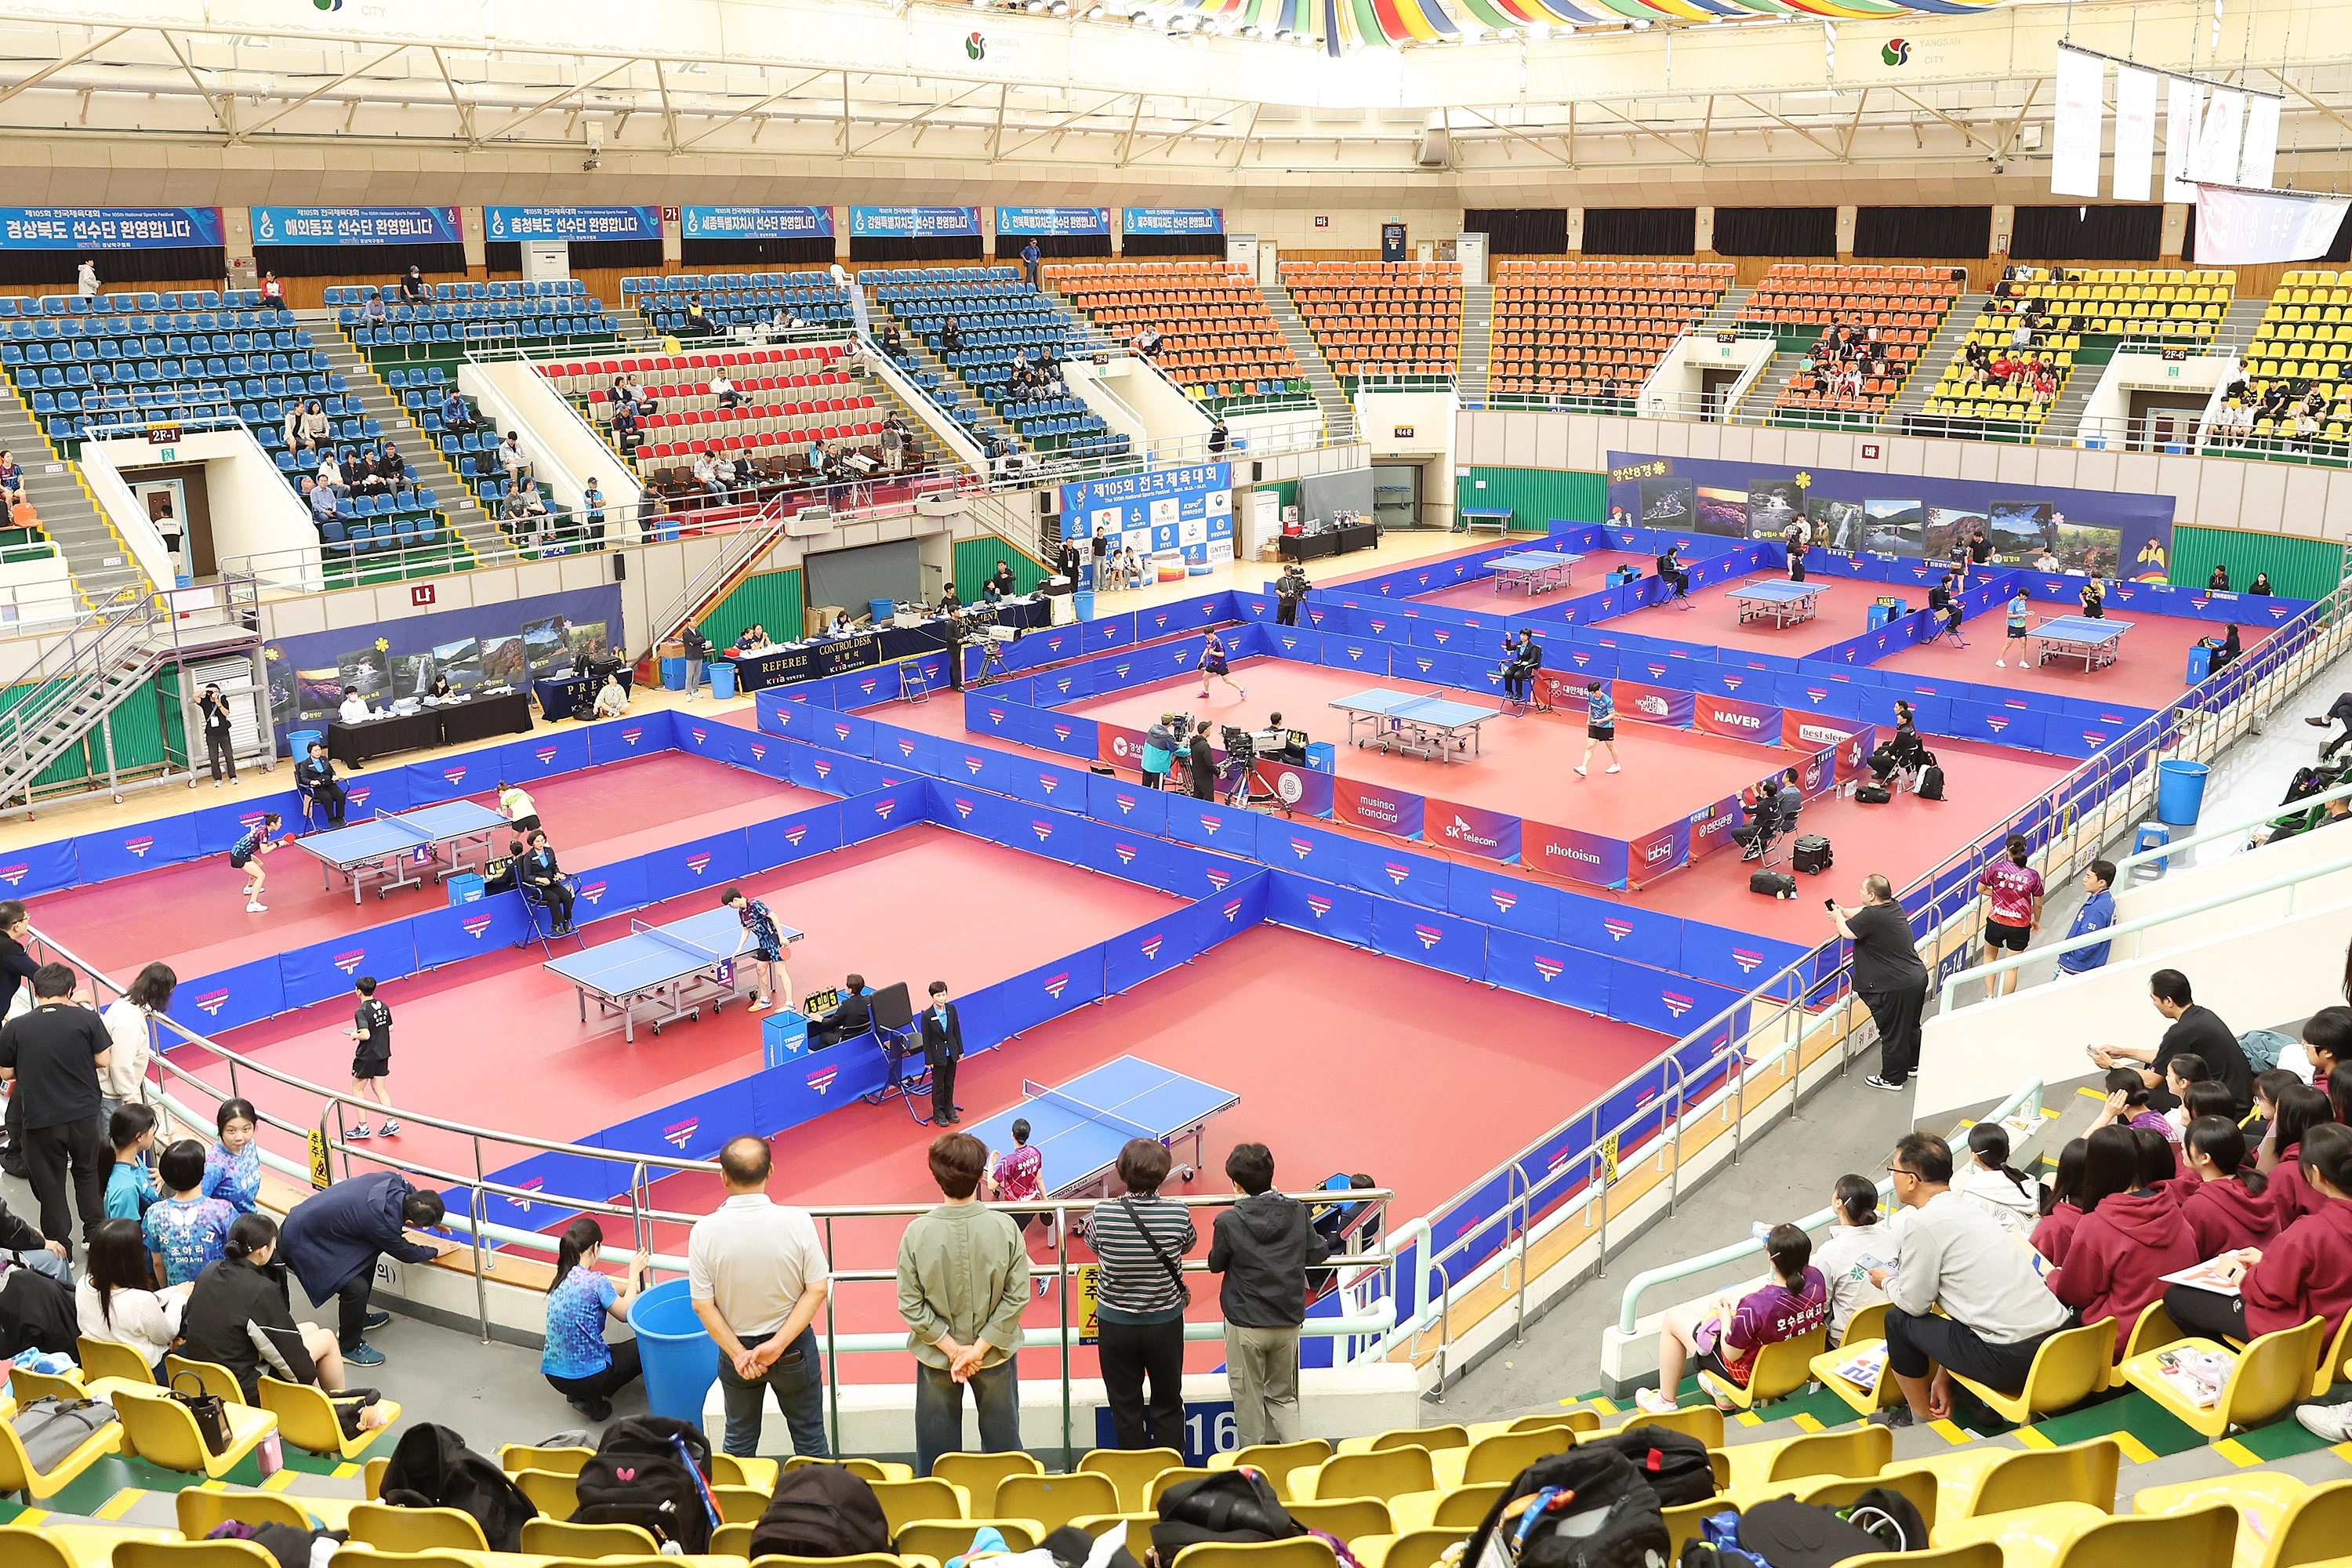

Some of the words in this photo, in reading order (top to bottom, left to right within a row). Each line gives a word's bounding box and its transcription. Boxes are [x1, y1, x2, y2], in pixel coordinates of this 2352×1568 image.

[361, 5, 386, 16] CITY
[989, 38, 1020, 48] YANGSAN
[1919, 38, 1961, 48] YANGSAN
[995, 55, 1010, 64] CITY
[1925, 56, 1945, 64] CITY
[24, 209, 52, 218] 제105회
[53, 209, 100, 219] 전국체육대회
[666, 209, 677, 220] 가
[285, 219, 333, 236] 해외동포
[337, 219, 373, 236] 선수단
[376, 218, 433, 235] 환영합니다
[511, 217, 554, 233] 충청북도
[556, 217, 586, 233] 선수단
[589, 217, 638, 232] 환영합니다
[702, 216, 754, 231] 세종특별자치시
[757, 216, 779, 231] 선수단
[780, 216, 815, 230] 환영합니다
[916, 216, 935, 229] 선수단
[936, 216, 967, 229] 환영합니다
[1053, 216, 1069, 228] 선수단
[1070, 216, 1097, 228] 환영합니다
[1174, 216, 1188, 228] 선수단
[1189, 216, 1212, 228] 환영합니다
[1316, 216, 1327, 227] 바
[6, 220, 67, 239] 경상북도
[72, 220, 116, 239] 선수단
[120, 220, 191, 238] 환영합니다
[2165, 350, 2185, 359] 2F-6
[152, 430, 177, 441] 2F-1
[1864, 446, 1878, 458] 바
[1613, 463, 1652, 482] 양산8경
[1093, 478, 1134, 497] 제105회
[1138, 466, 1218, 492] 전국체육대회
[1155, 488, 1171, 497] Festival
[415, 587, 431, 603] 나
[819, 641, 854, 655] CONTROL
[854, 635, 872, 651] DESK
[761, 655, 808, 673] REFEREE
[567, 677, 608, 695] PRES
[1563, 684, 1591, 696] 대한체육
[1635, 699, 1657, 711] NORTH
[1644, 695, 1657, 703] THE
[1641, 706, 1657, 715] FACE
[1394, 720, 1399, 731] 1
[1714, 710, 1761, 729] NAVER
[1802, 728, 1824, 739] best
[1129, 742, 1145, 753] 경상
[1360, 796, 1396, 811] musinsa
[1357, 807, 1398, 823] standard
[1710, 806, 1715, 816] 0
[1707, 813, 1733, 833] 한진관광
[1445, 825, 1460, 839] SK
[1464, 832, 1497, 848] telecom
[416, 848, 425, 860] 4
[1545, 843, 1600, 865] photoism
[1647, 842, 1671, 862] bbq
[489, 863, 495, 876] 4
[462, 913, 492, 924] TAGRO
[1604, 916, 1634, 929] TAGRO
[2087, 922, 2096, 931] 51
[332, 947, 365, 960] TAGRO
[1732, 946, 1764, 960] TAGRO
[1534, 954, 1564, 968] TAGRO
[1940, 949, 1963, 986] 2-14
[720, 965, 728, 979] 5
[194, 986, 230, 1002] TAGRO
[1662, 989, 1694, 1004] TAGRO
[810, 999, 817, 1013] 5
[818, 996, 823, 1007] 0
[823, 994, 829, 1005] 0
[829, 992, 837, 1006] 5
[783, 1033, 804, 1044] TAGRO
[805, 1063, 838, 1080] TAGRO
[662, 1116, 699, 1134] TAGRO
[1051, 1186, 1073, 1200] TAGRO
[171, 1244, 205, 1256] 조아라
[1777, 1303, 1823, 1332] 호수돈여고
